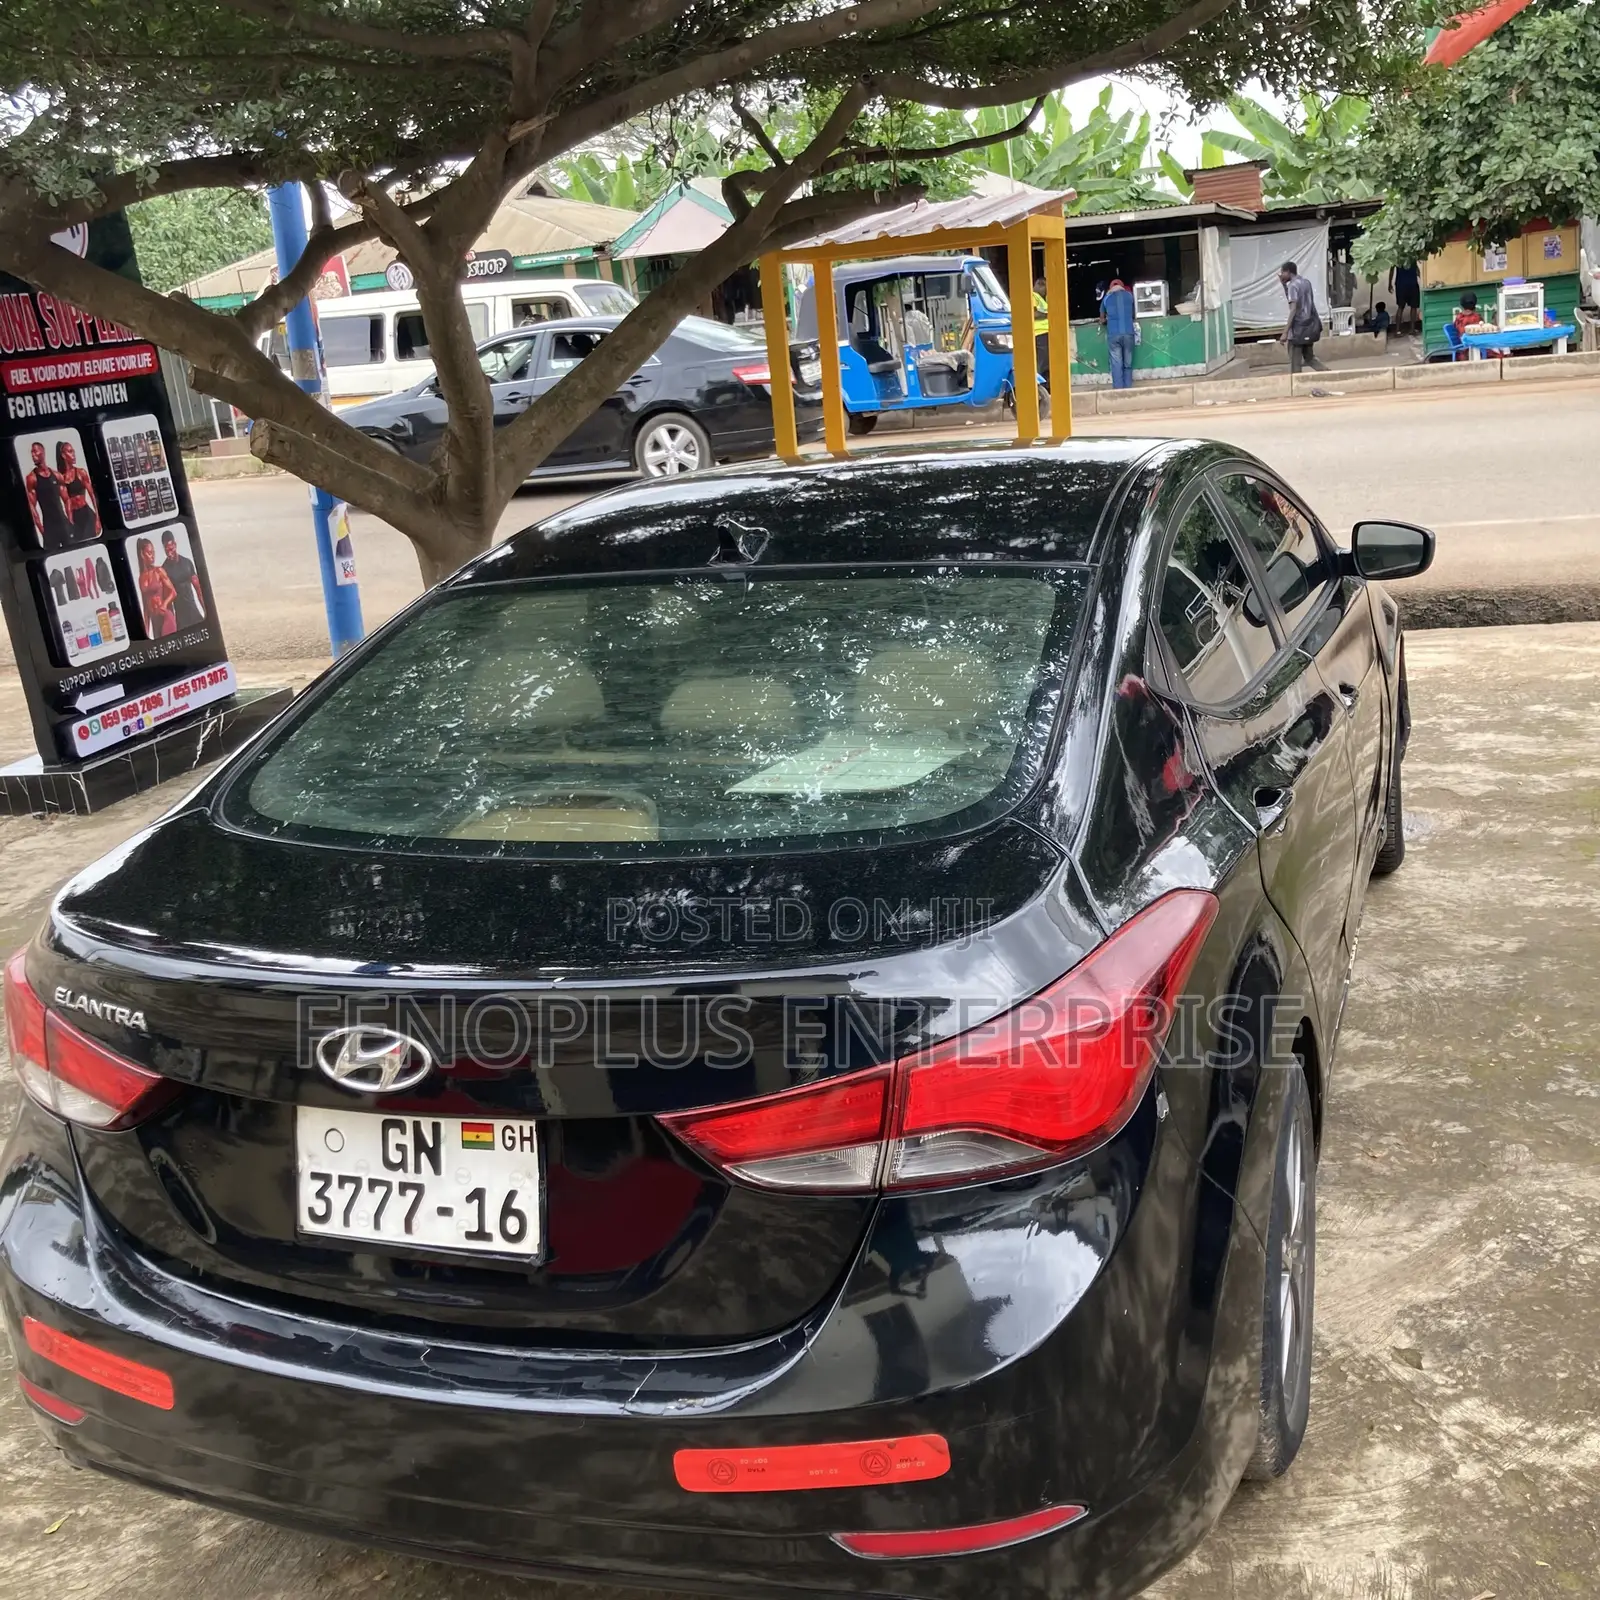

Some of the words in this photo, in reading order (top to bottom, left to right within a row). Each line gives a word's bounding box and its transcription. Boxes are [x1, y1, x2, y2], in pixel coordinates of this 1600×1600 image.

[10, 369, 32, 386] FUEL
[32, 365, 57, 382] YOUR
[58, 361, 82, 379] BODY.
[84, 357, 116, 375] ELEVATE
[115, 355, 137, 371] YOUR
[137, 353, 153, 368] LIFE
[7, 395, 36, 419] FOR
[37, 390, 67, 415] MEN
[69, 392, 80, 410] &
[80, 382, 129, 409] WOMEN
[59, 669, 94, 693] SUPPORT
[95, 661, 118, 678] YOUR
[119, 652, 144, 670] GOALS
[147, 646, 159, 660] WE
[160, 638, 182, 656] SUPPLY
[184, 628, 210, 646] RESULTS
[54, 986, 148, 1033] ELANTRA
[381, 1118, 442, 1176] GN
[501, 1124, 535, 1153] GH
[307, 1171, 528, 1244] 3777-16
